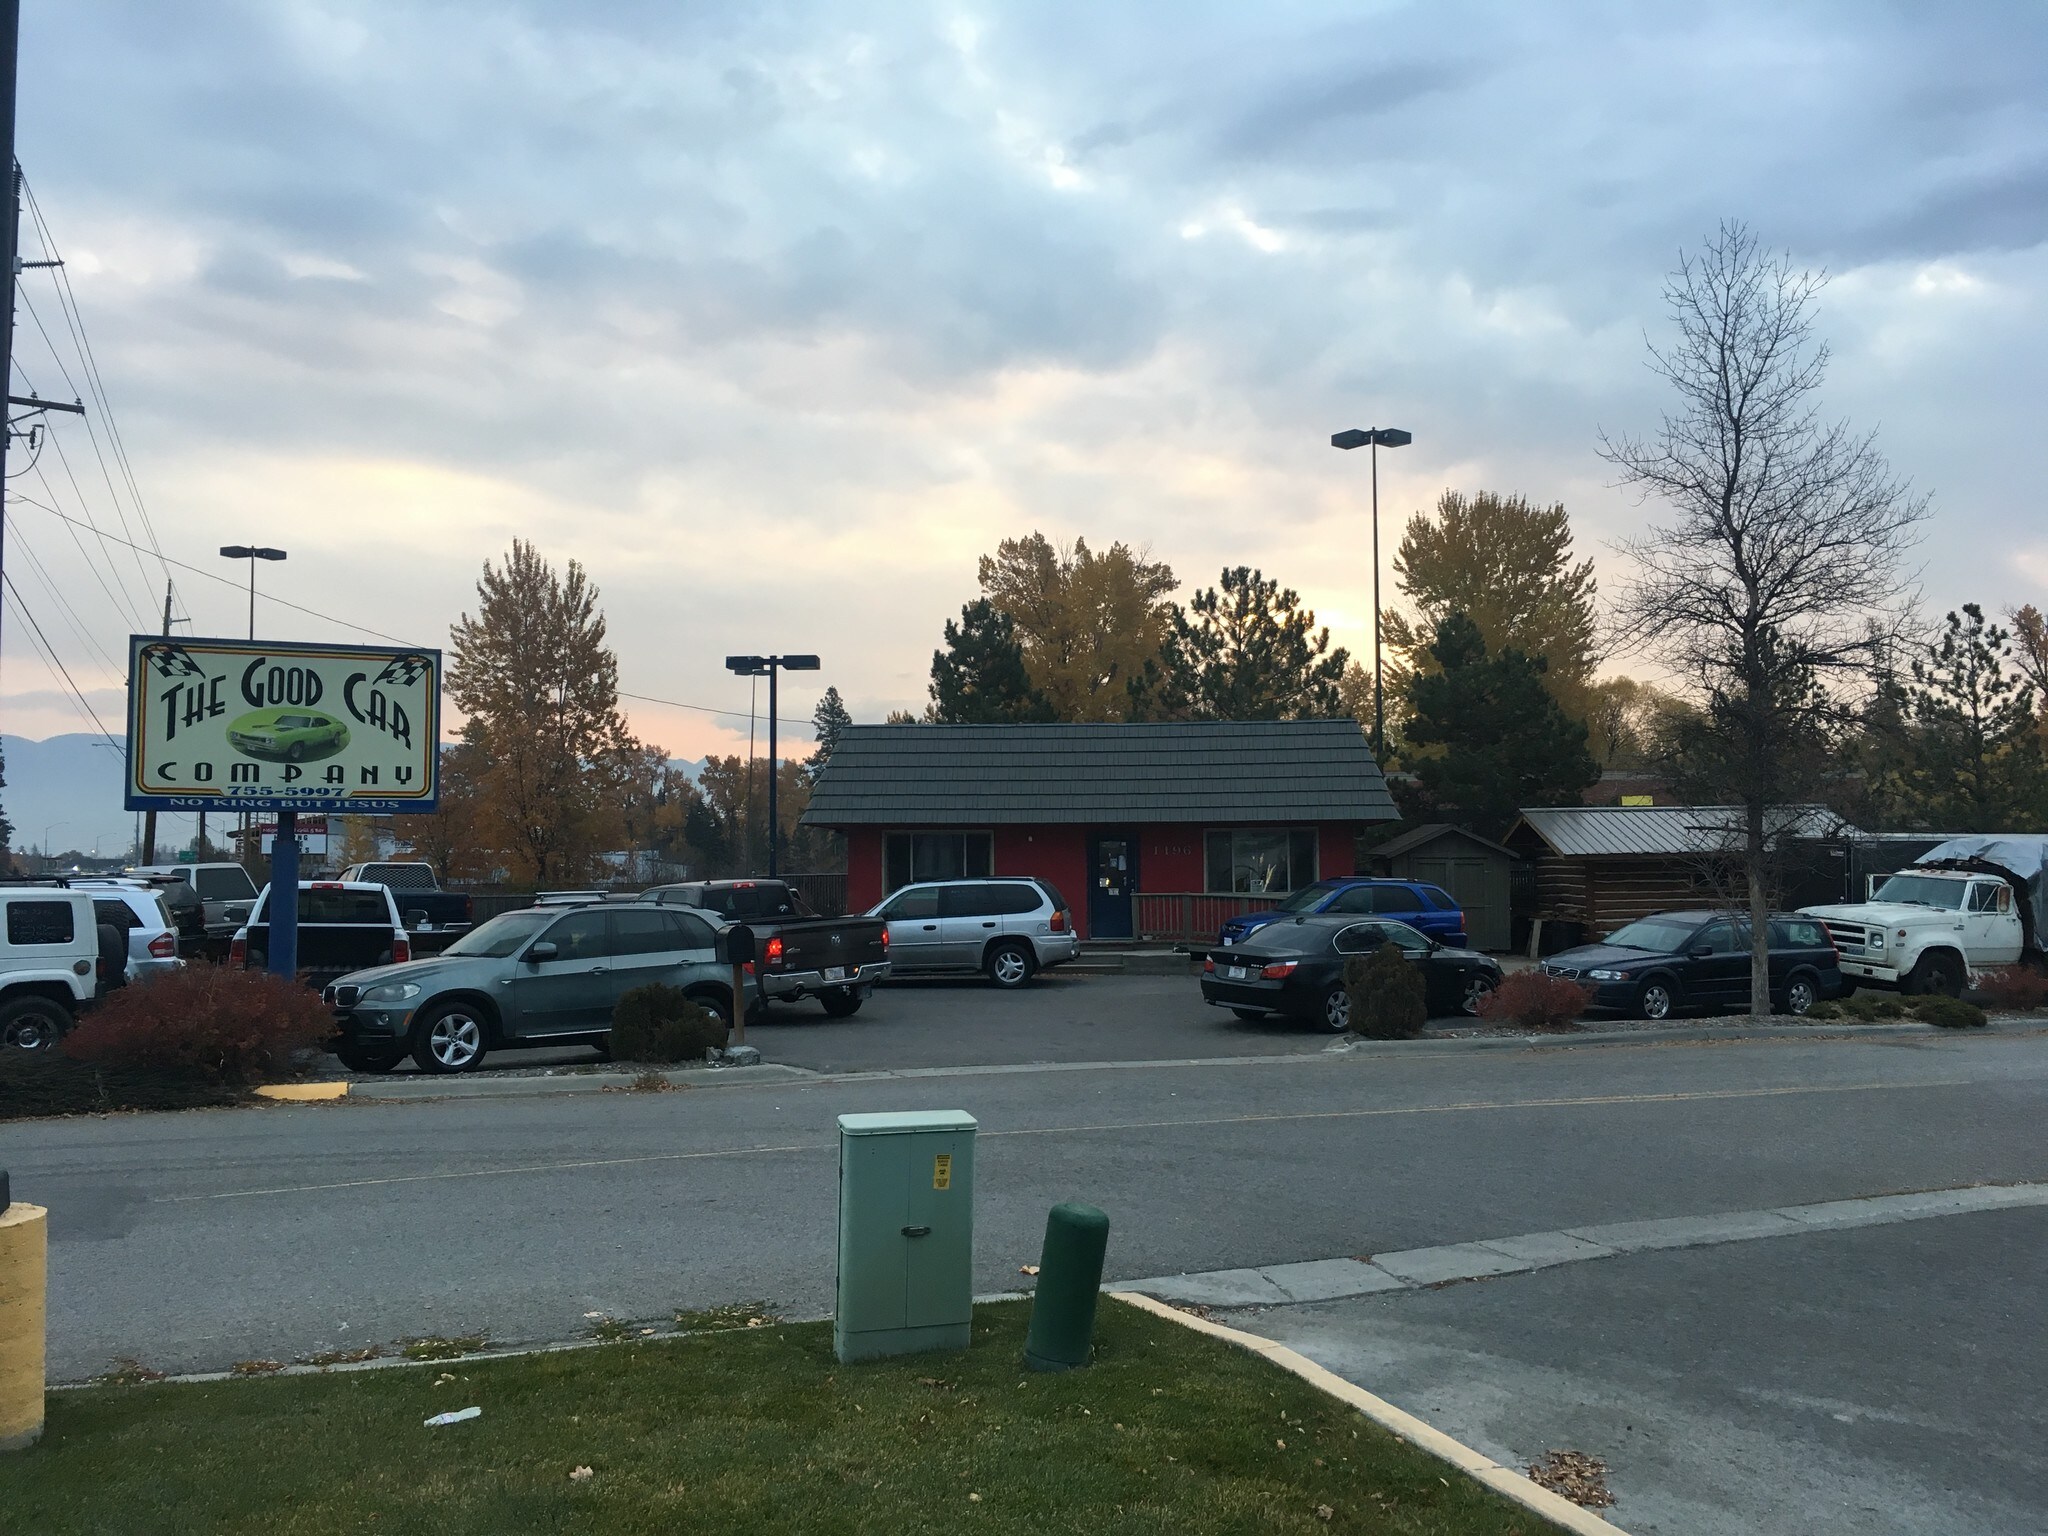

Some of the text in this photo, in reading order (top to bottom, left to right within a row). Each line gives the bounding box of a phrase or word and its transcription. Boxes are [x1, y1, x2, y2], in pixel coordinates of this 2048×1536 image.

[161, 657, 411, 750] THE GOOD CAR
[157, 762, 412, 785] COMPANY
[227, 786, 346, 797] 755-5997
[170, 798, 400, 809] NO KING BUT JESUS
